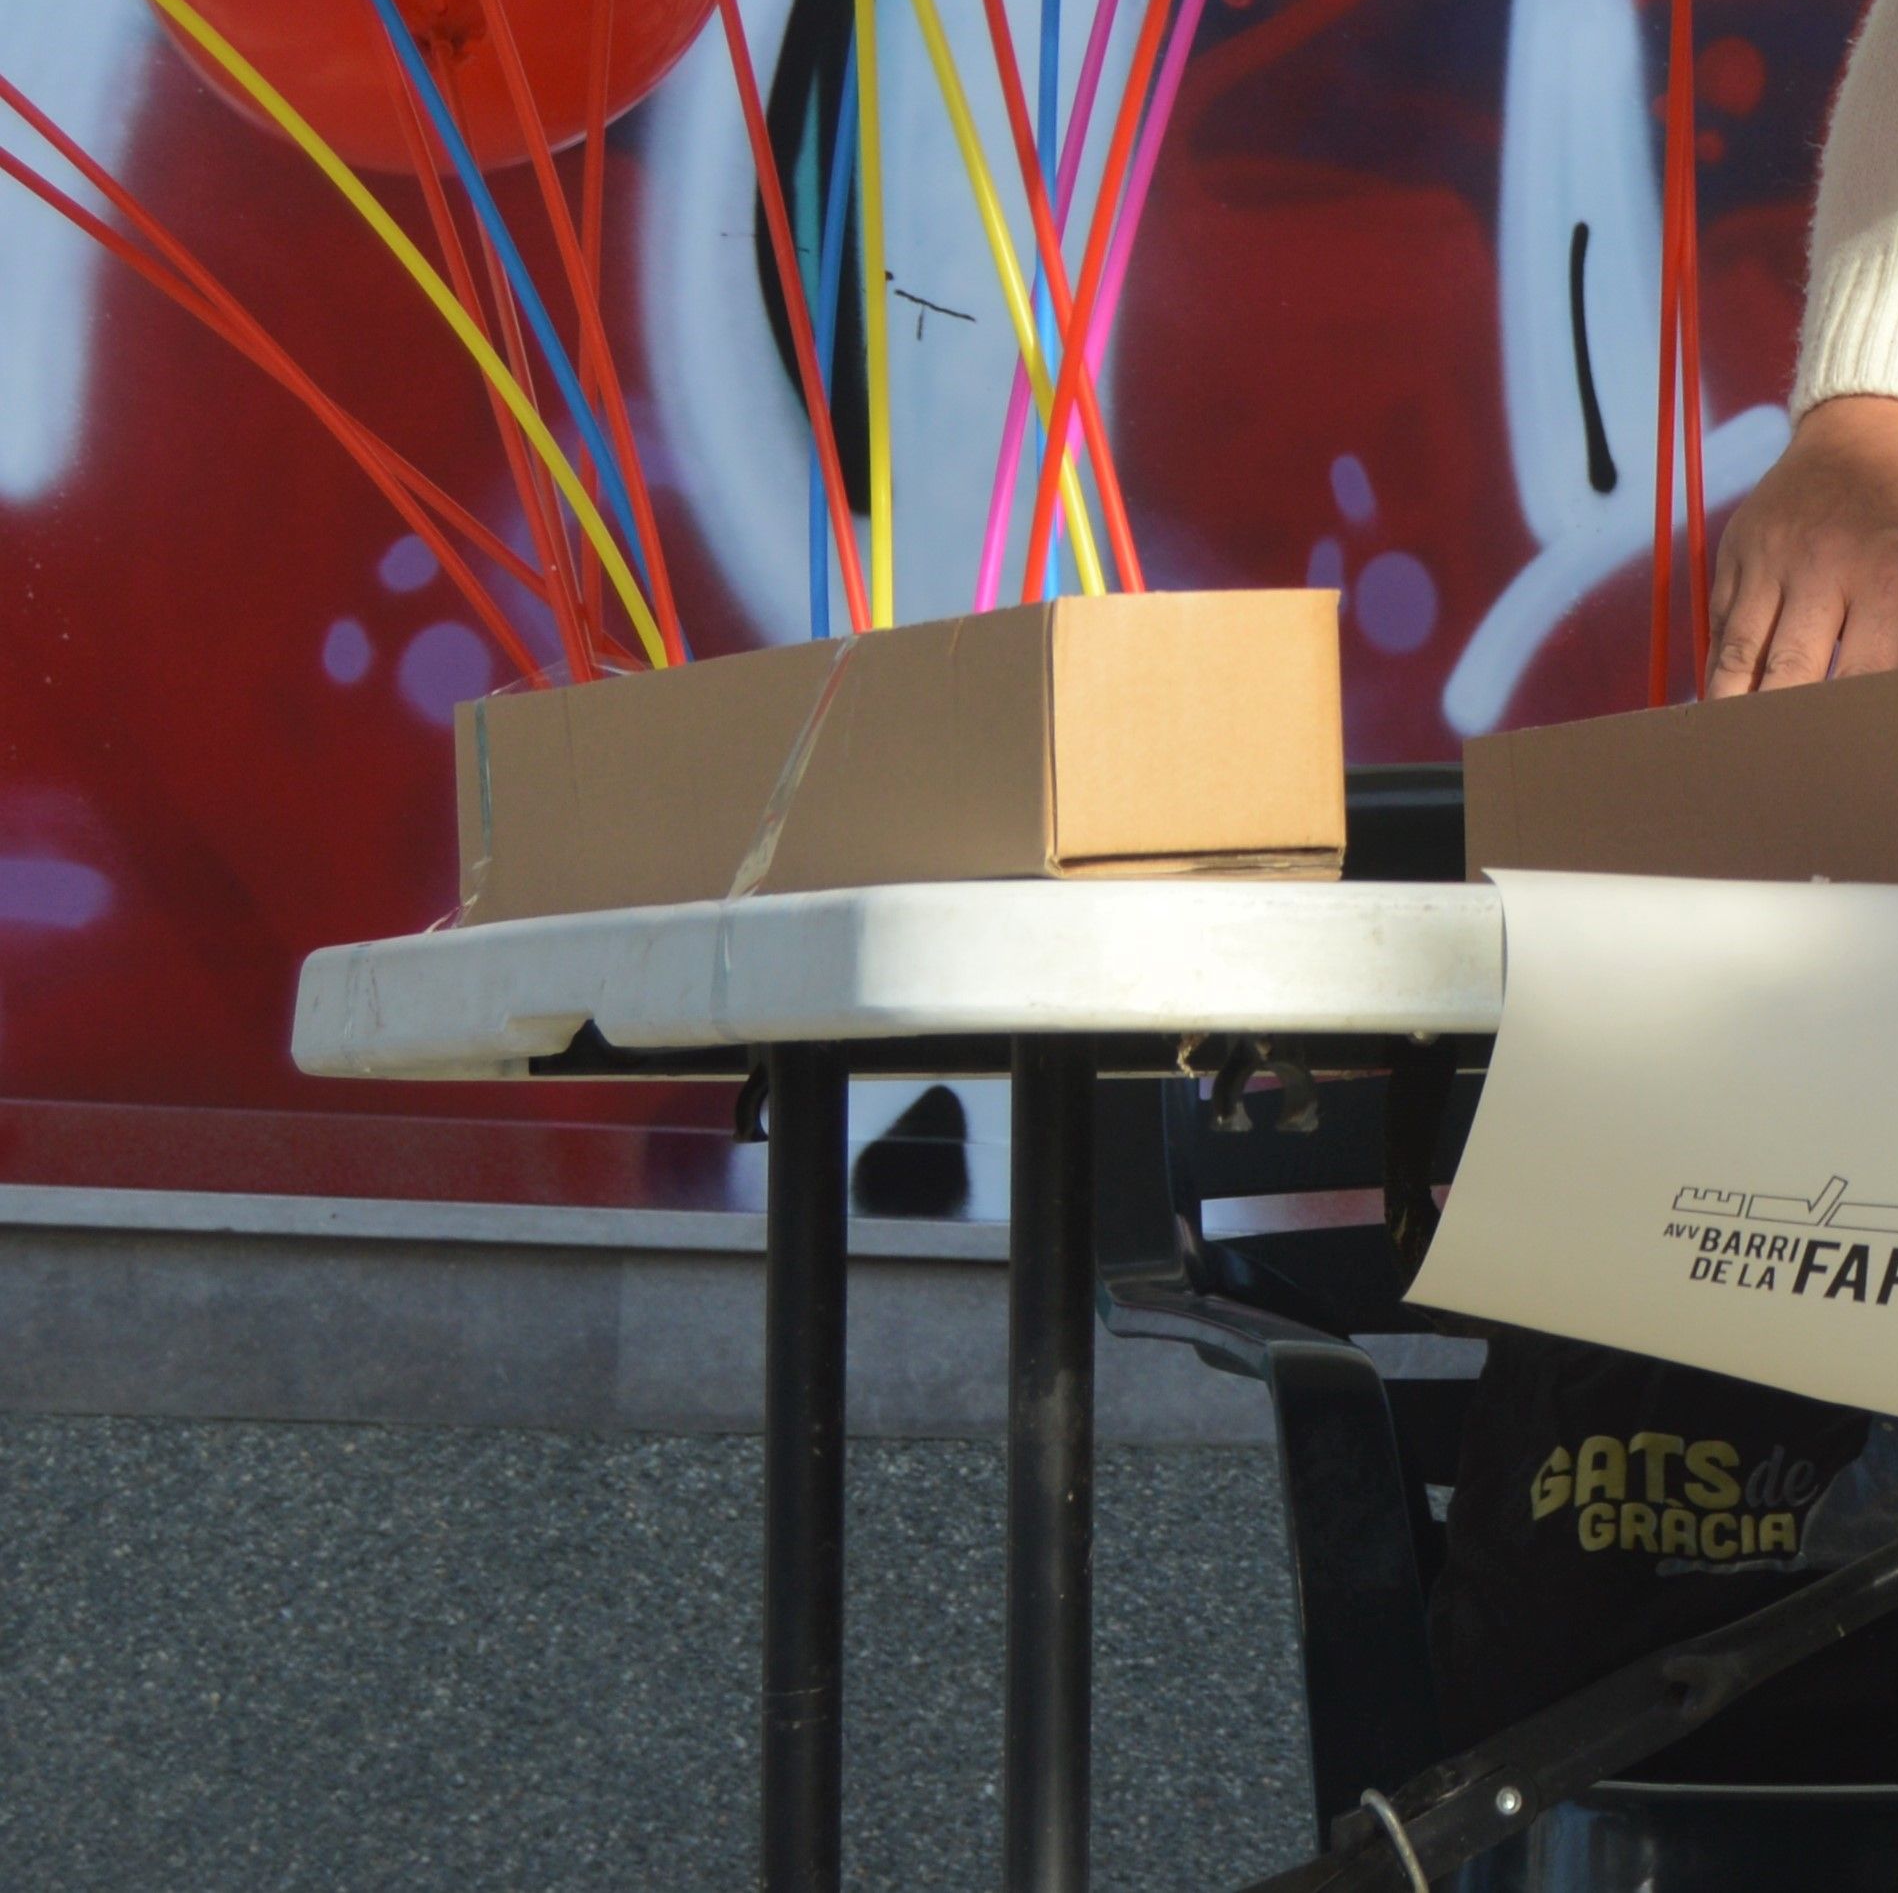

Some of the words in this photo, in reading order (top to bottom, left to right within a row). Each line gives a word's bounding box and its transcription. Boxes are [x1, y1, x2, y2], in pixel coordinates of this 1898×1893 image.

[1663, 1223, 1699, 1241] AVV
[1698, 1225, 1801, 1263] BARRI
[1690, 1256, 1730, 1284] DE
[1736, 1261, 1776, 1291] LA
[1530, 1431, 1742, 1521] GATS
[1744, 1443, 1821, 1508] de
[1577, 1498, 1797, 1560] GRÀCIA
